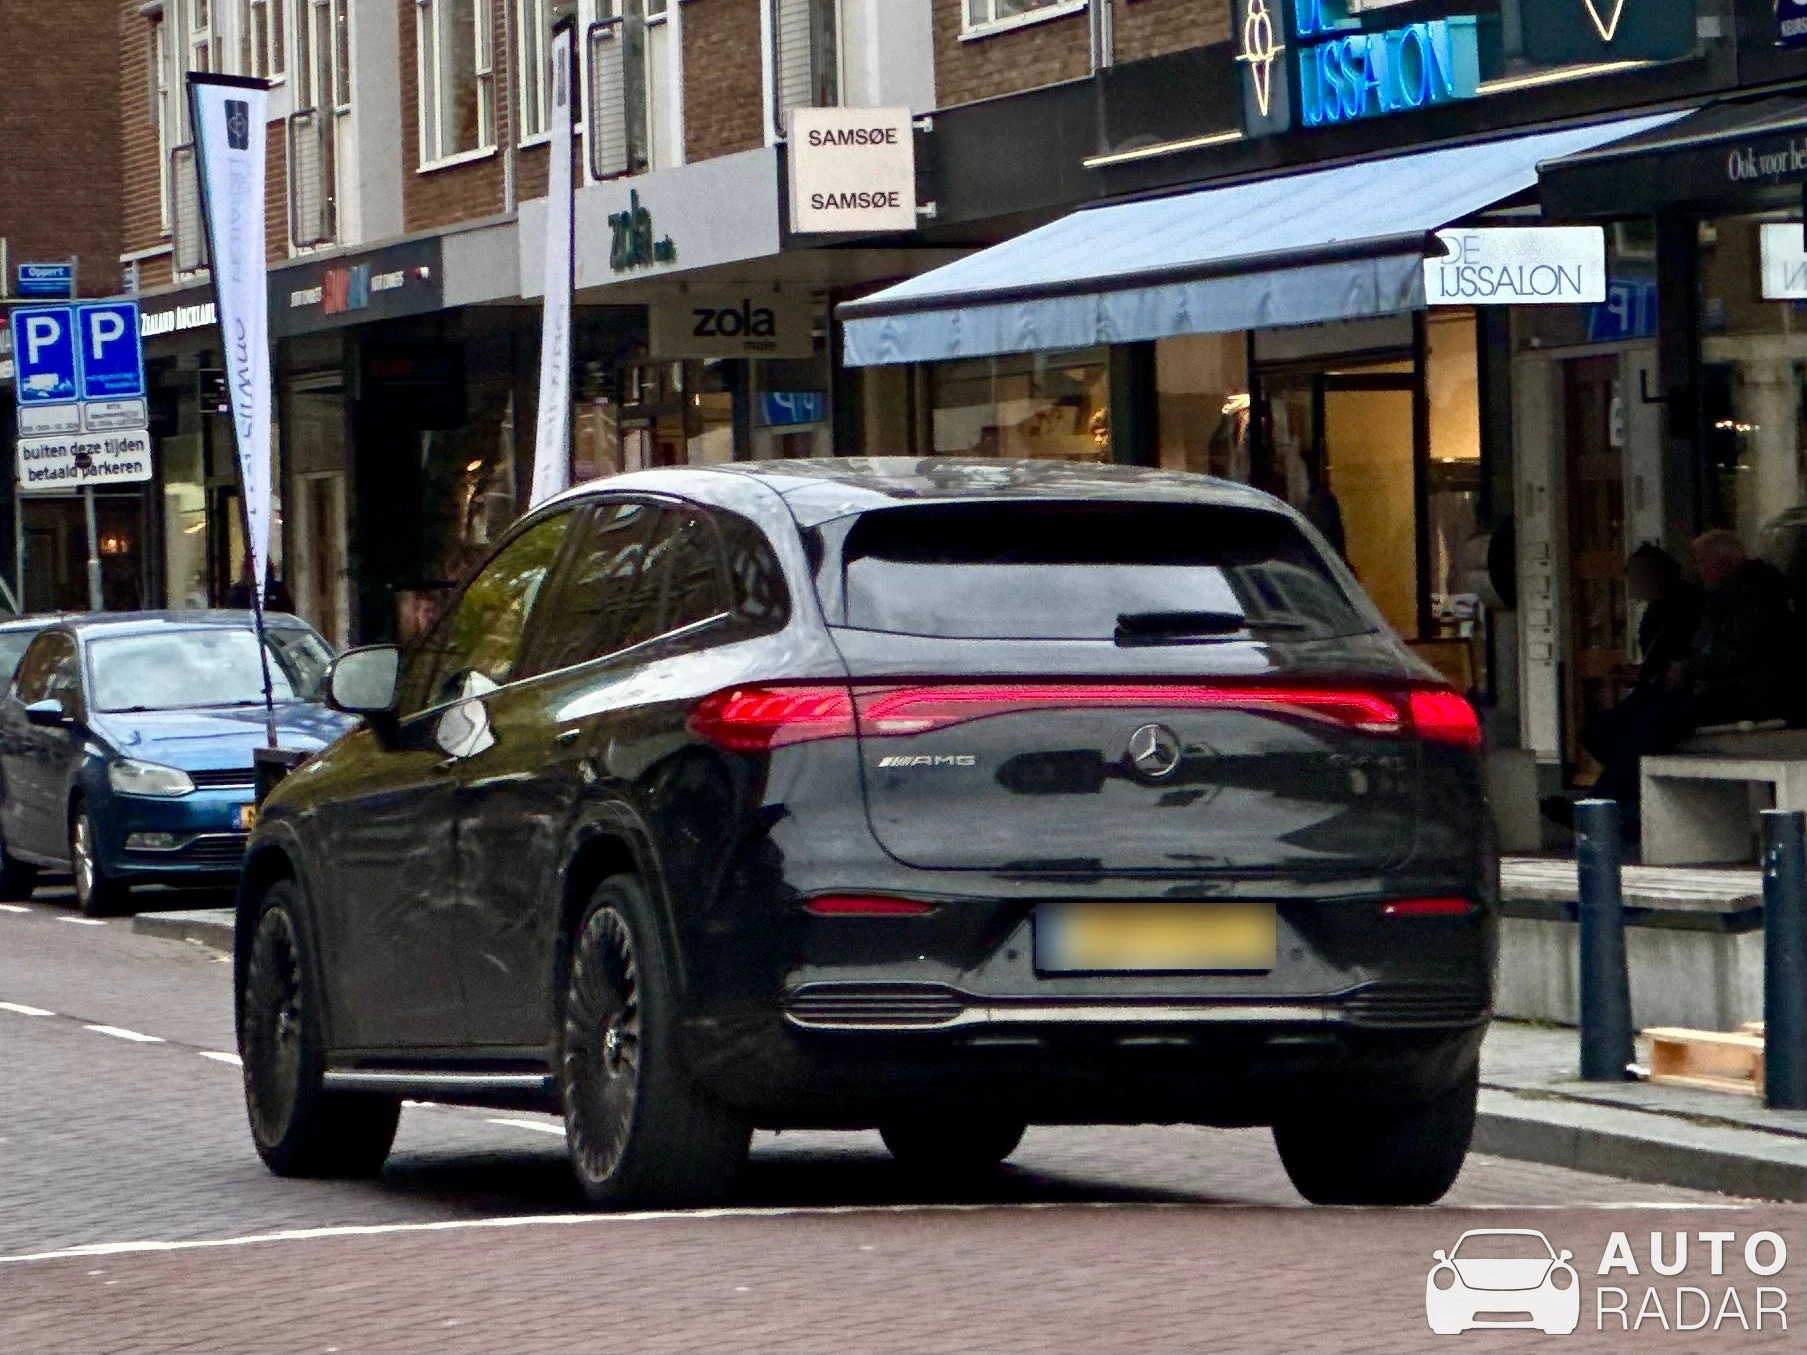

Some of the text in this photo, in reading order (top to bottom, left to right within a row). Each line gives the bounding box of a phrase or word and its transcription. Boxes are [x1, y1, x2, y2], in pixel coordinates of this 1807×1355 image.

[808, 128, 899, 146] SAMSØE
[1728, 148, 1758, 181] Ook
[811, 191, 901, 209] SAMSØE
[1441, 235, 1480, 264] DE
[1440, 264, 1582, 297] IJSSALON
[693, 298, 776, 337] zola
[26, 316, 60, 364] P
[90, 311, 124, 359] P
[23, 438, 144, 460] buiten deze tijden
